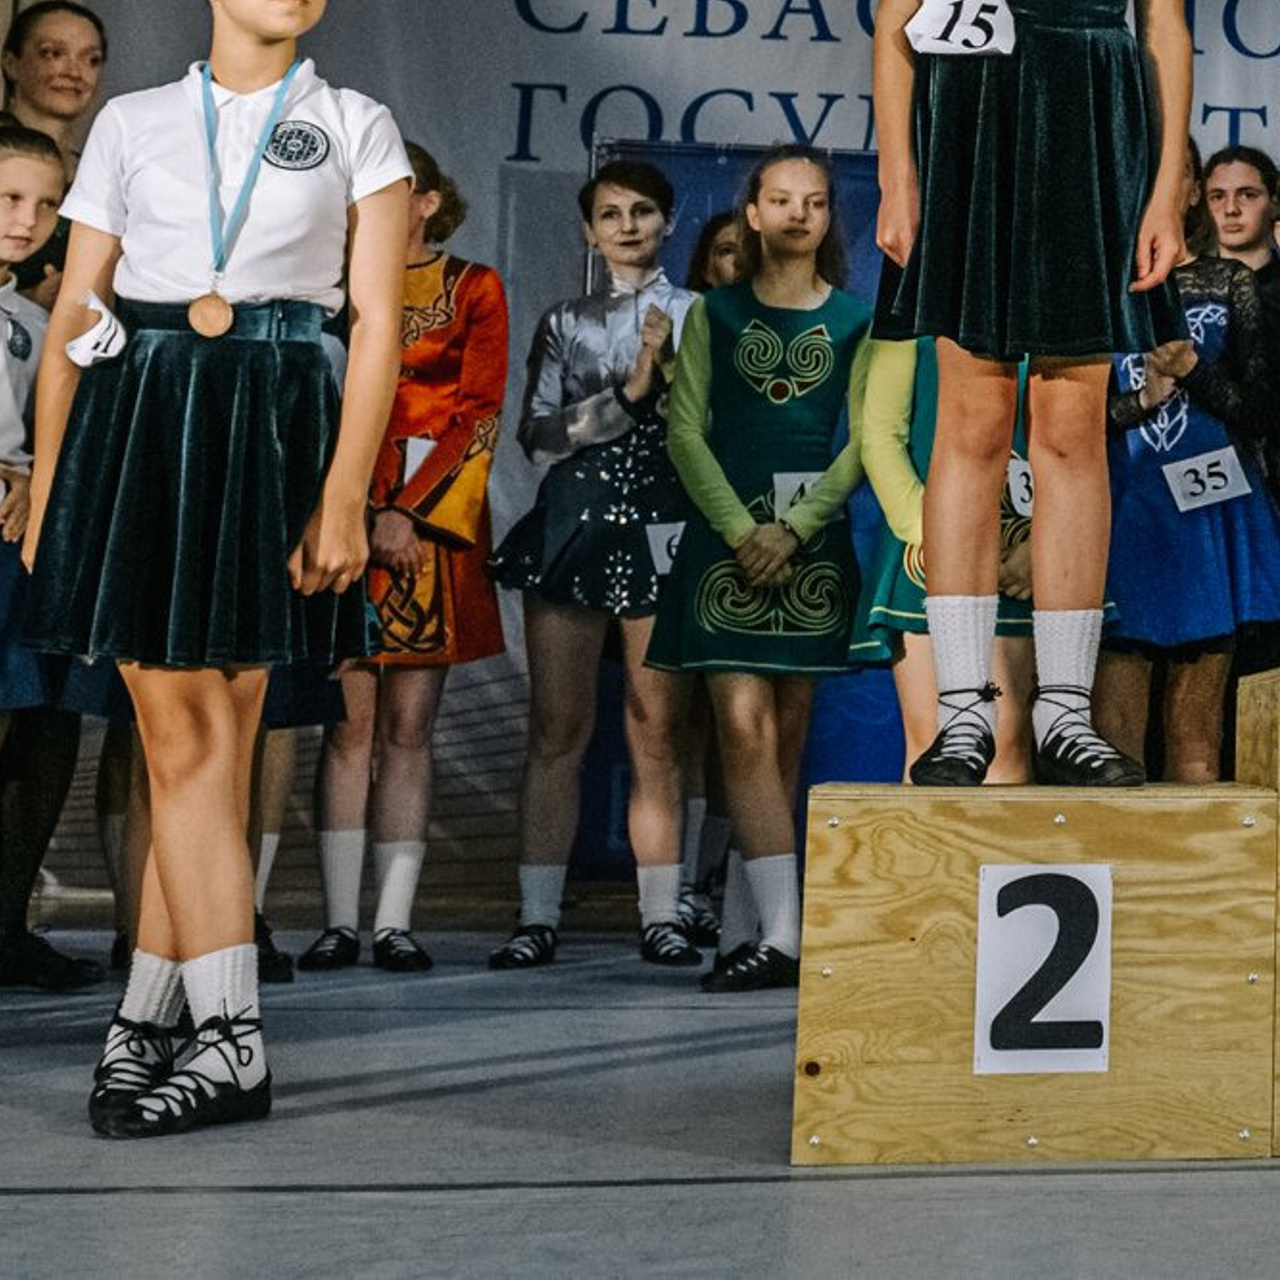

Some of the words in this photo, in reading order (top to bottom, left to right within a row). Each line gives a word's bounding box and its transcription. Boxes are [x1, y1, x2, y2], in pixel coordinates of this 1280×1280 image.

[933, 0, 999, 49] 15
[1183, 461, 1229, 498] 35
[989, 872, 1104, 1051] 2
